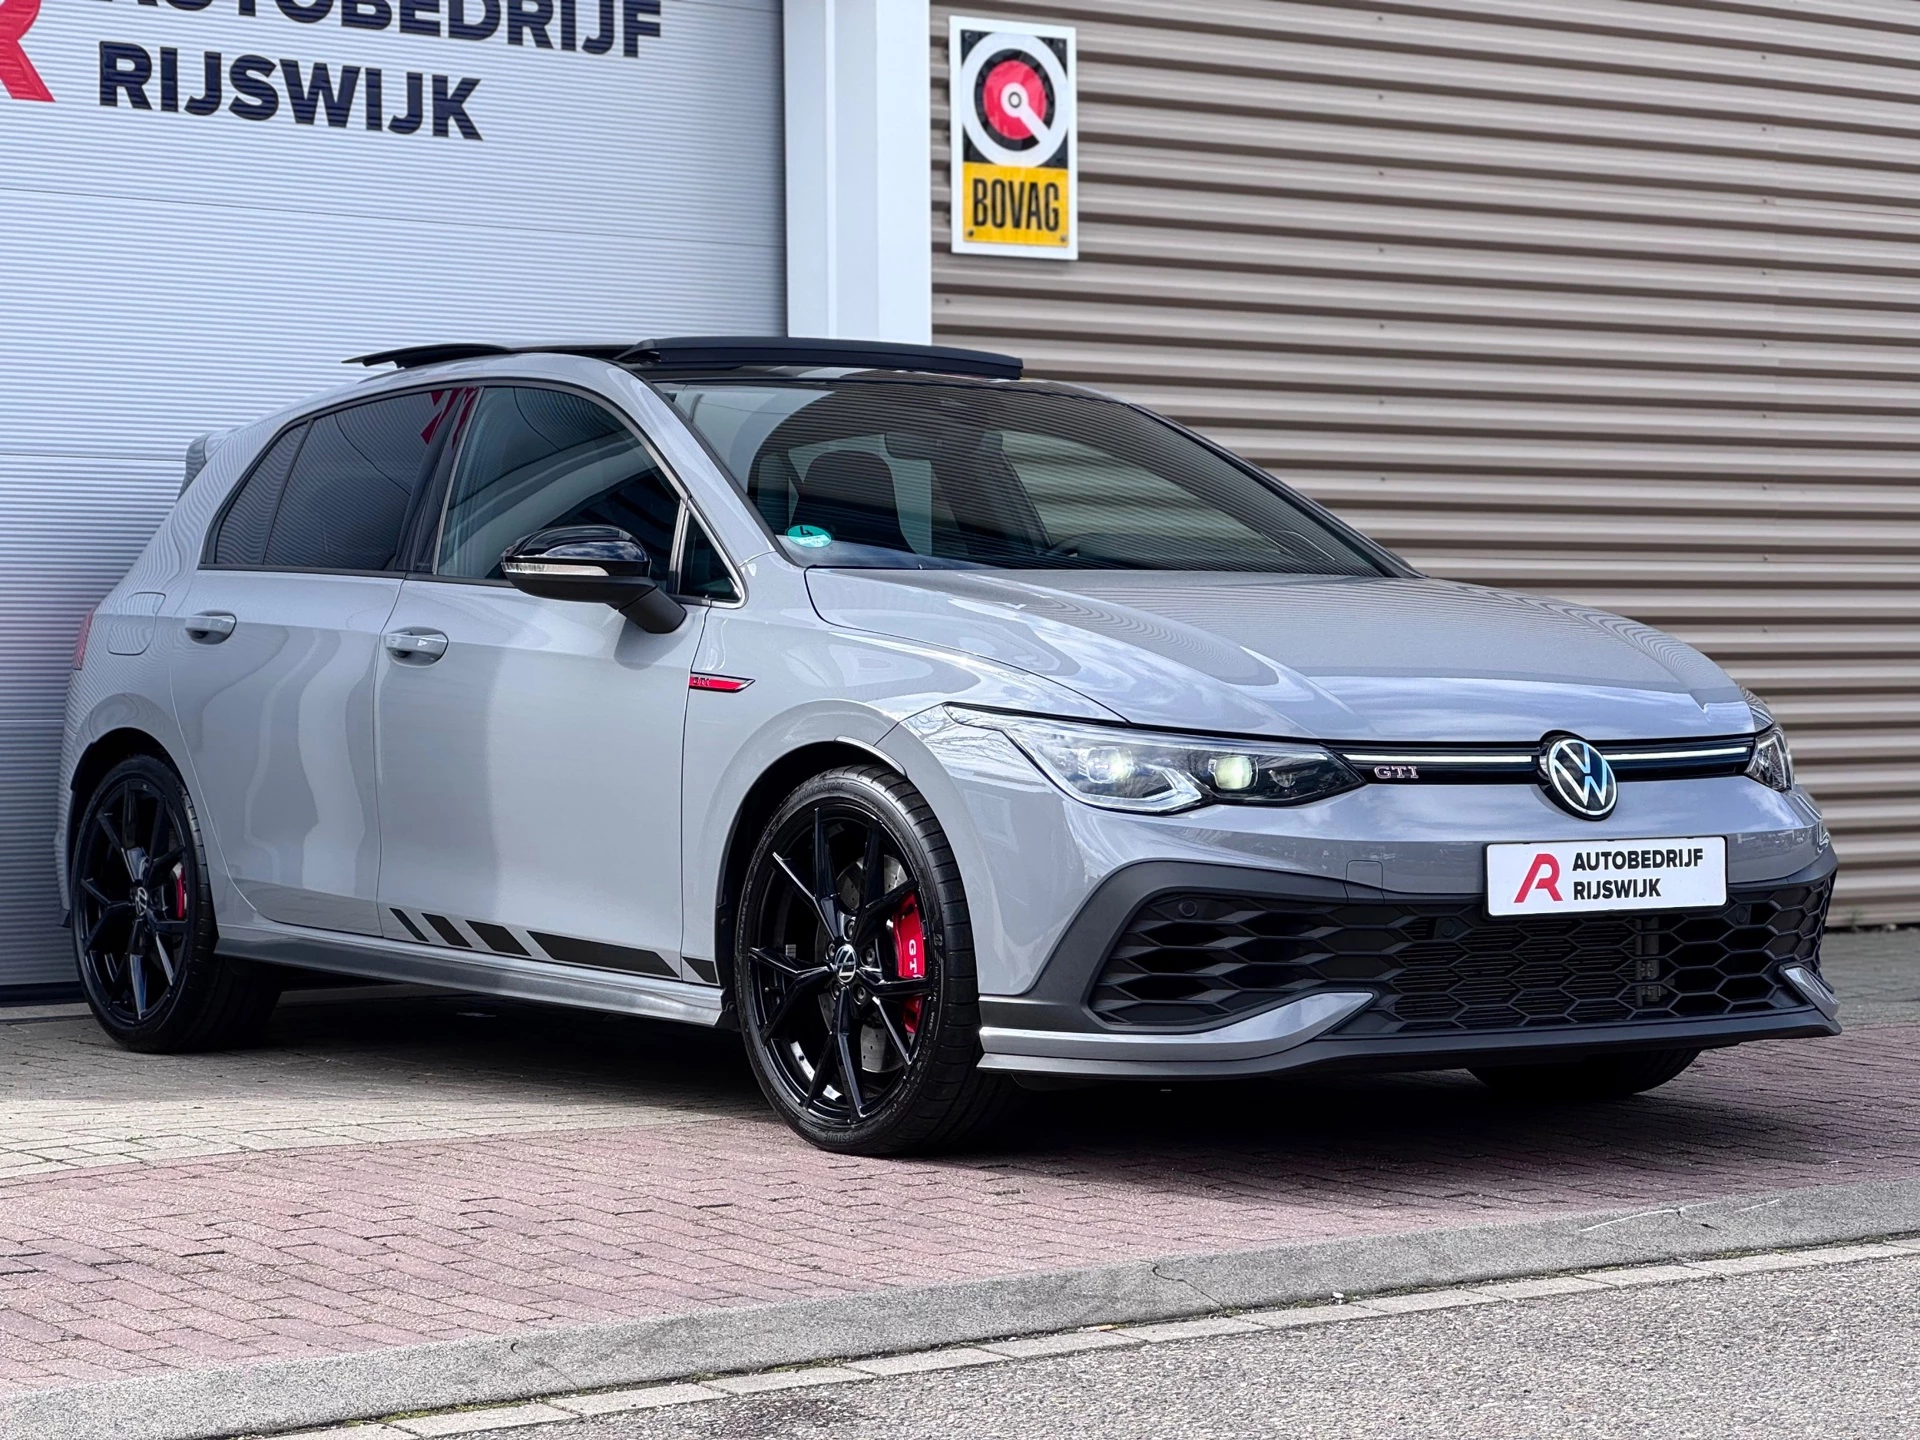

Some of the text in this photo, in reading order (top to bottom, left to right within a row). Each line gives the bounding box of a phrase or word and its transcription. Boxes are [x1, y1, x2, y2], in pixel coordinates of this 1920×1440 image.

[97, 0, 662, 58] EDRIJF
[99, 41, 483, 141] RIJSWIJK
[972, 178, 1059, 231] BOVAG
[1374, 765, 1419, 779] GTI
[1572, 848, 1704, 871] AUTOBEDRIJF
[1573, 878, 1661, 900] RIJSWIJK
[908, 939, 922, 978] GT
